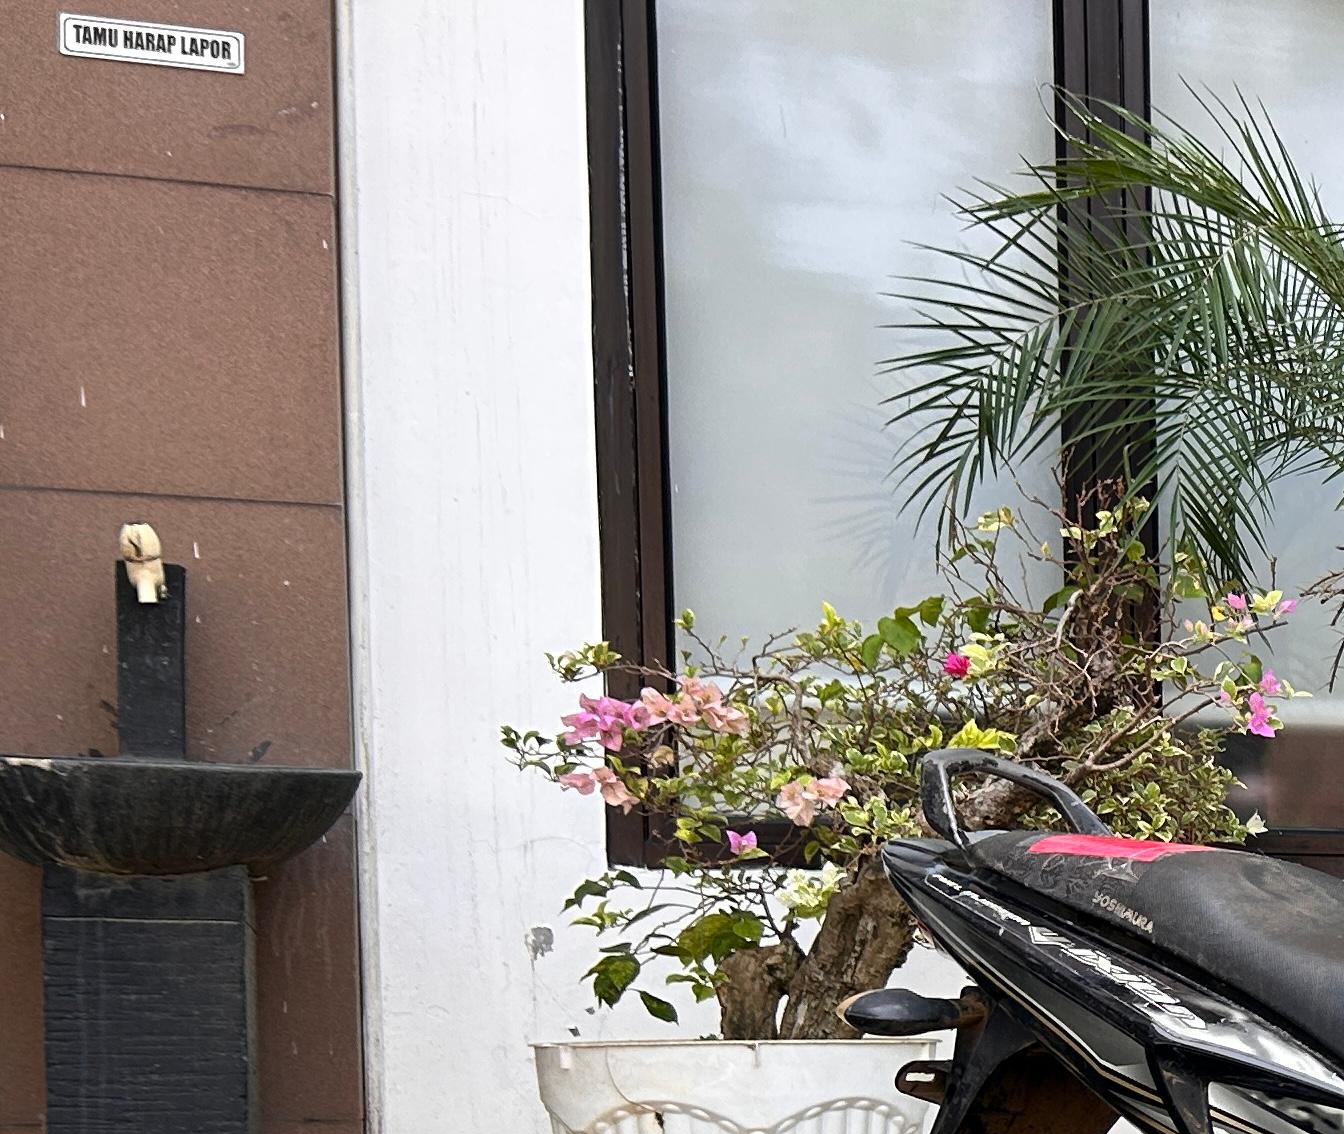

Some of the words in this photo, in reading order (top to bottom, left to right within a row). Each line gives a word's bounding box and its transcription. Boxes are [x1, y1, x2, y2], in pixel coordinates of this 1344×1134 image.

[73, 24, 118, 48] TAMU
[123, 30, 176, 54] HARAP
[181, 36, 231, 60] LAPOR
